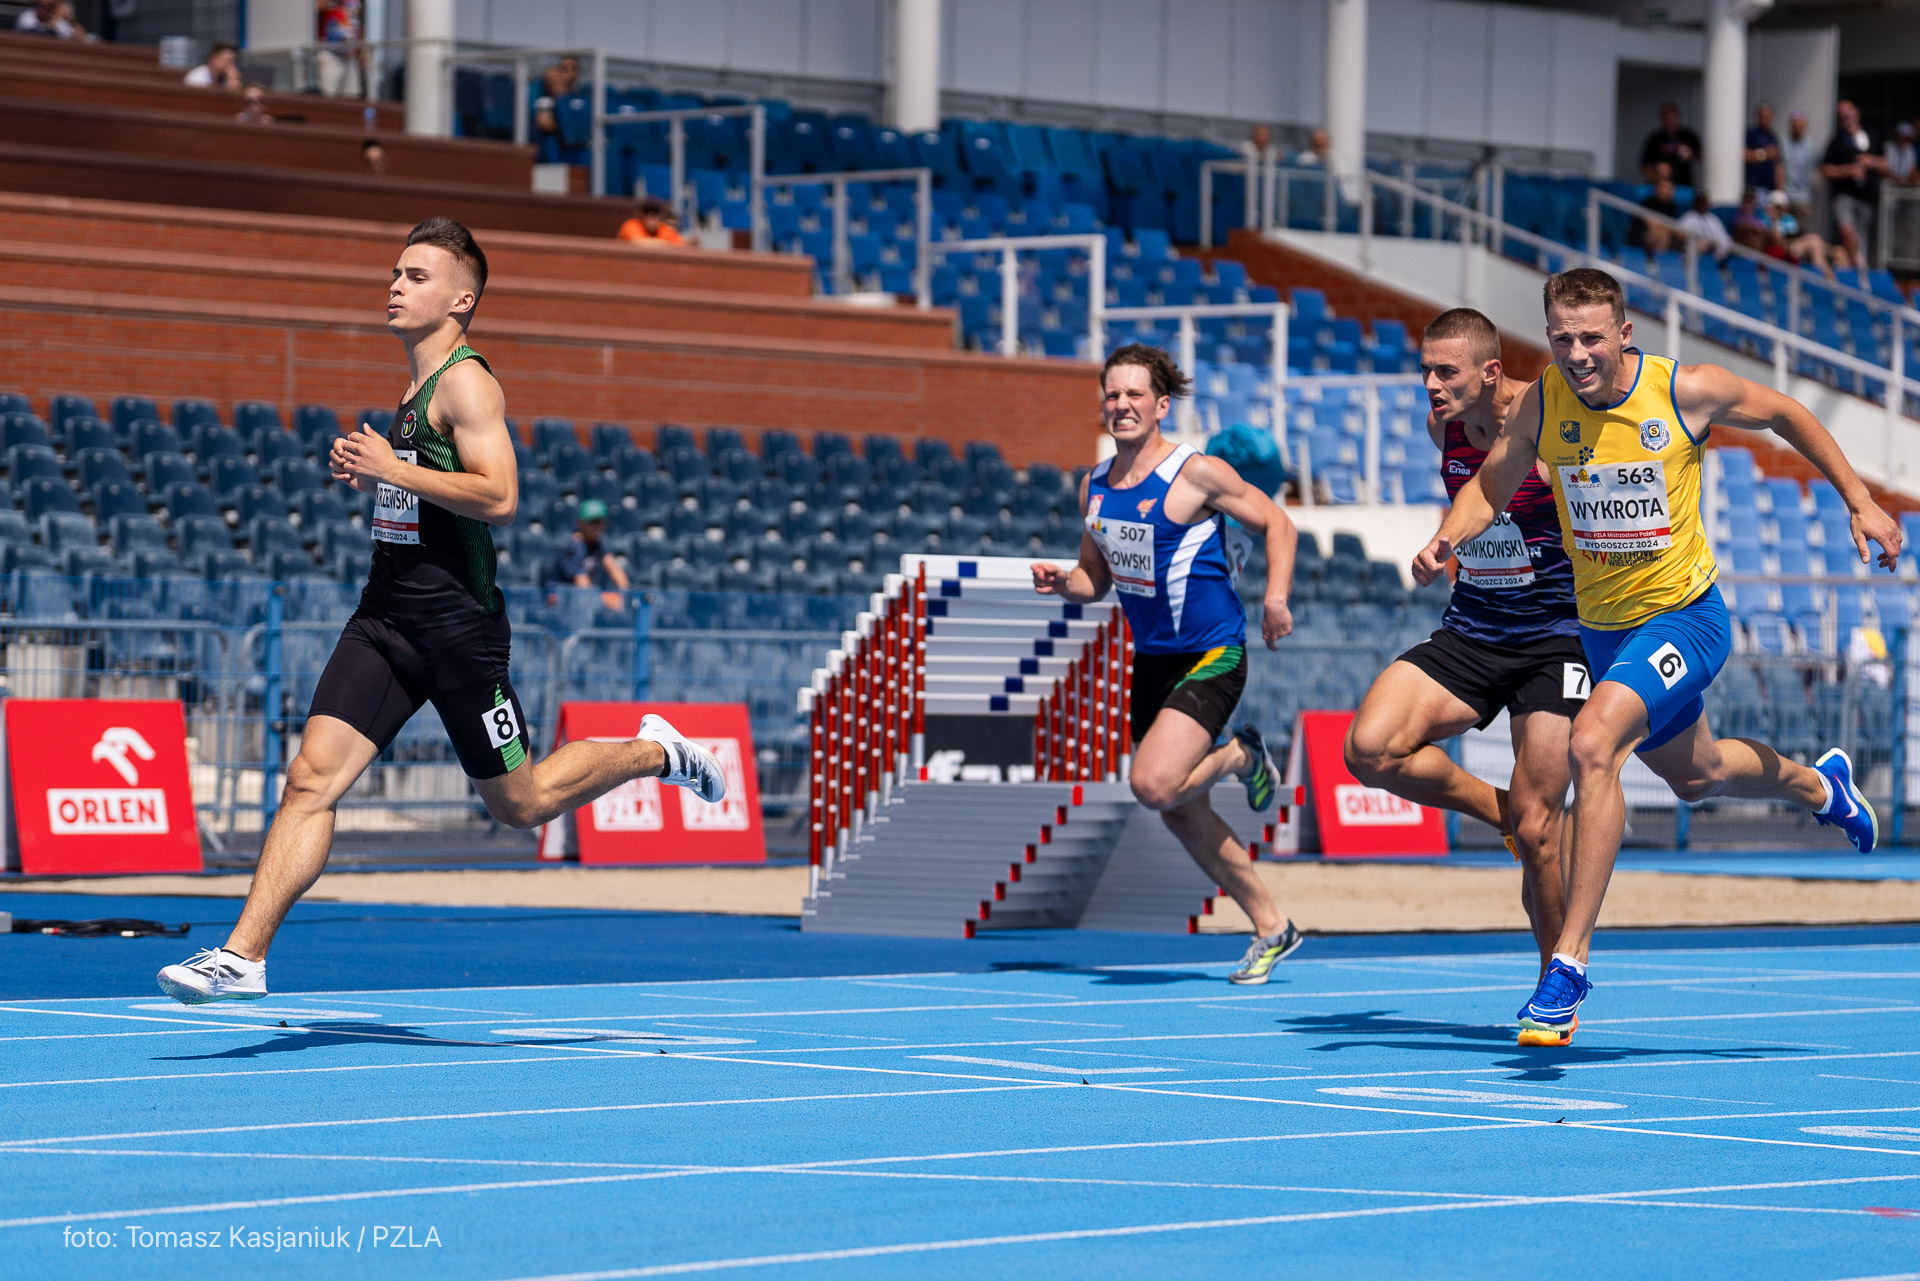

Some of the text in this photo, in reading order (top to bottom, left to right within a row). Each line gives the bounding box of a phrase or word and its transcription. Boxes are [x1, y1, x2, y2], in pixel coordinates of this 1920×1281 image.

[1449, 465, 1471, 475] Enea
[1617, 467, 1655, 485] 563
[1570, 497, 1664, 520] WYKROTA
[1119, 525, 1147, 542] 507
[1584, 540, 1659, 549] BYDGOSZCZ 2024
[1504, 576, 1524, 585] 2024
[1659, 652, 1682, 678] 6
[1572, 666, 1587, 695] 7
[493, 708, 514, 740] 8
[58, 799, 157, 824] ORLEN
